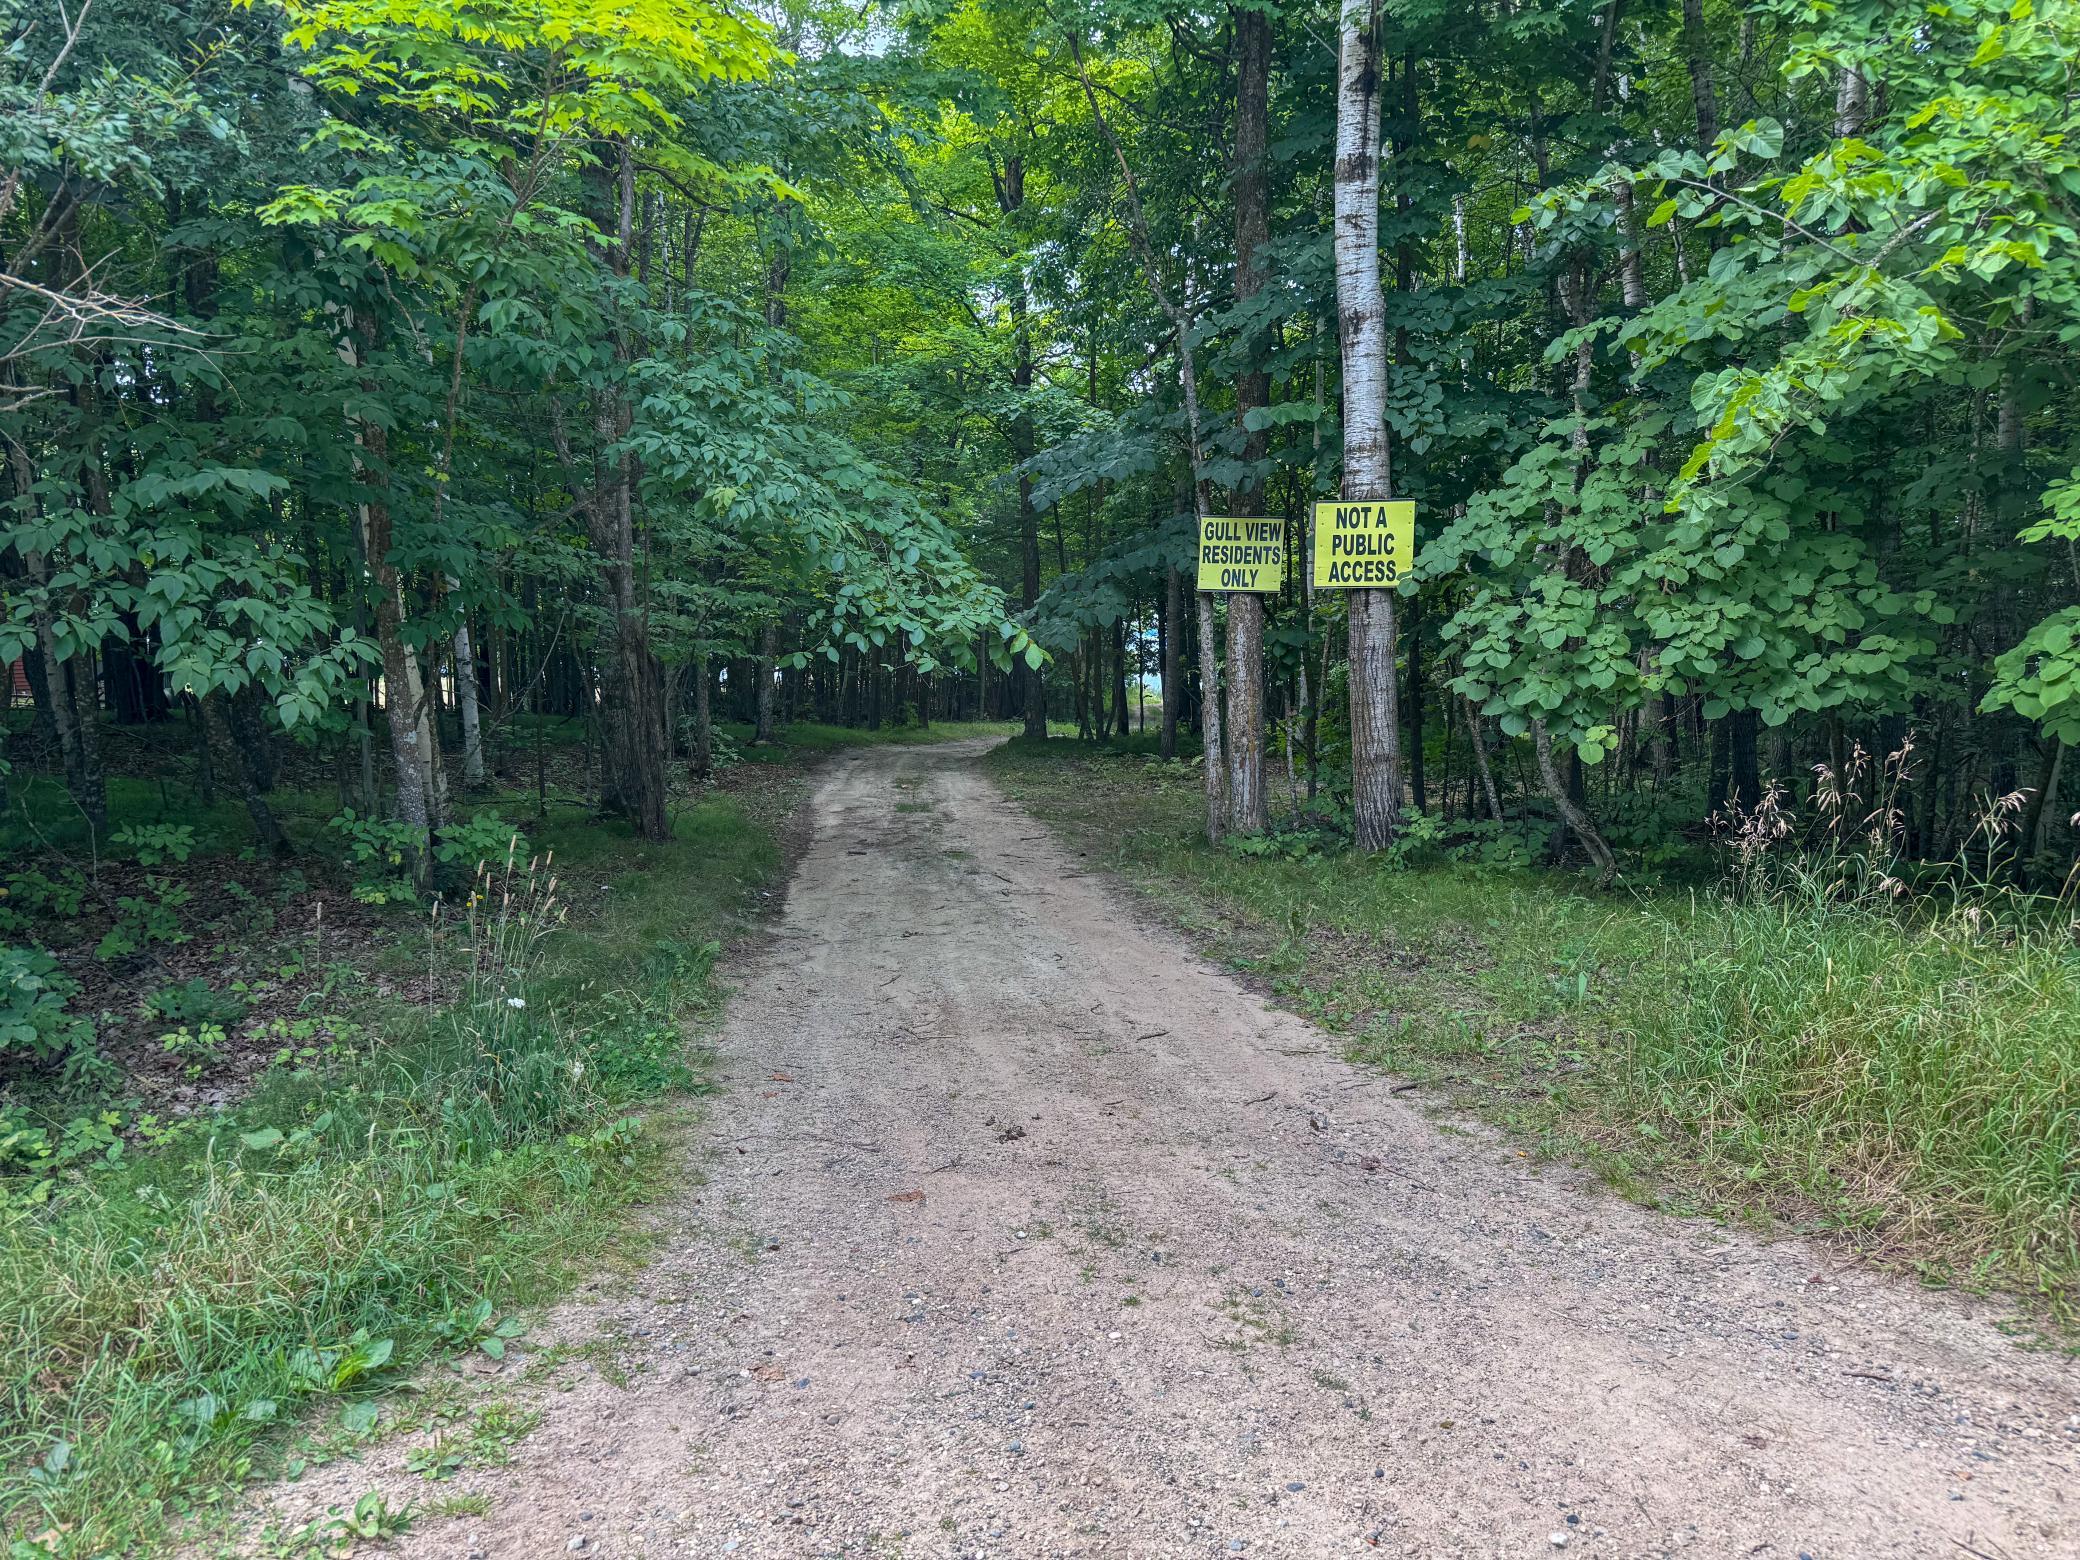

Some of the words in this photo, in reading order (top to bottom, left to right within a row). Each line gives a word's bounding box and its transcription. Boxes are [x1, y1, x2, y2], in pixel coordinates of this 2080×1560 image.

[1336, 507, 1372, 529] NOT
[1375, 507, 1388, 528] A
[1204, 521, 1241, 541] GULL
[1245, 522, 1281, 541] VIEW
[1202, 545, 1281, 565] RESIDENTS
[1332, 533, 1395, 556] PUBLIC
[1221, 568, 1259, 587] ONLY
[1328, 560, 1396, 582] ACCESS
